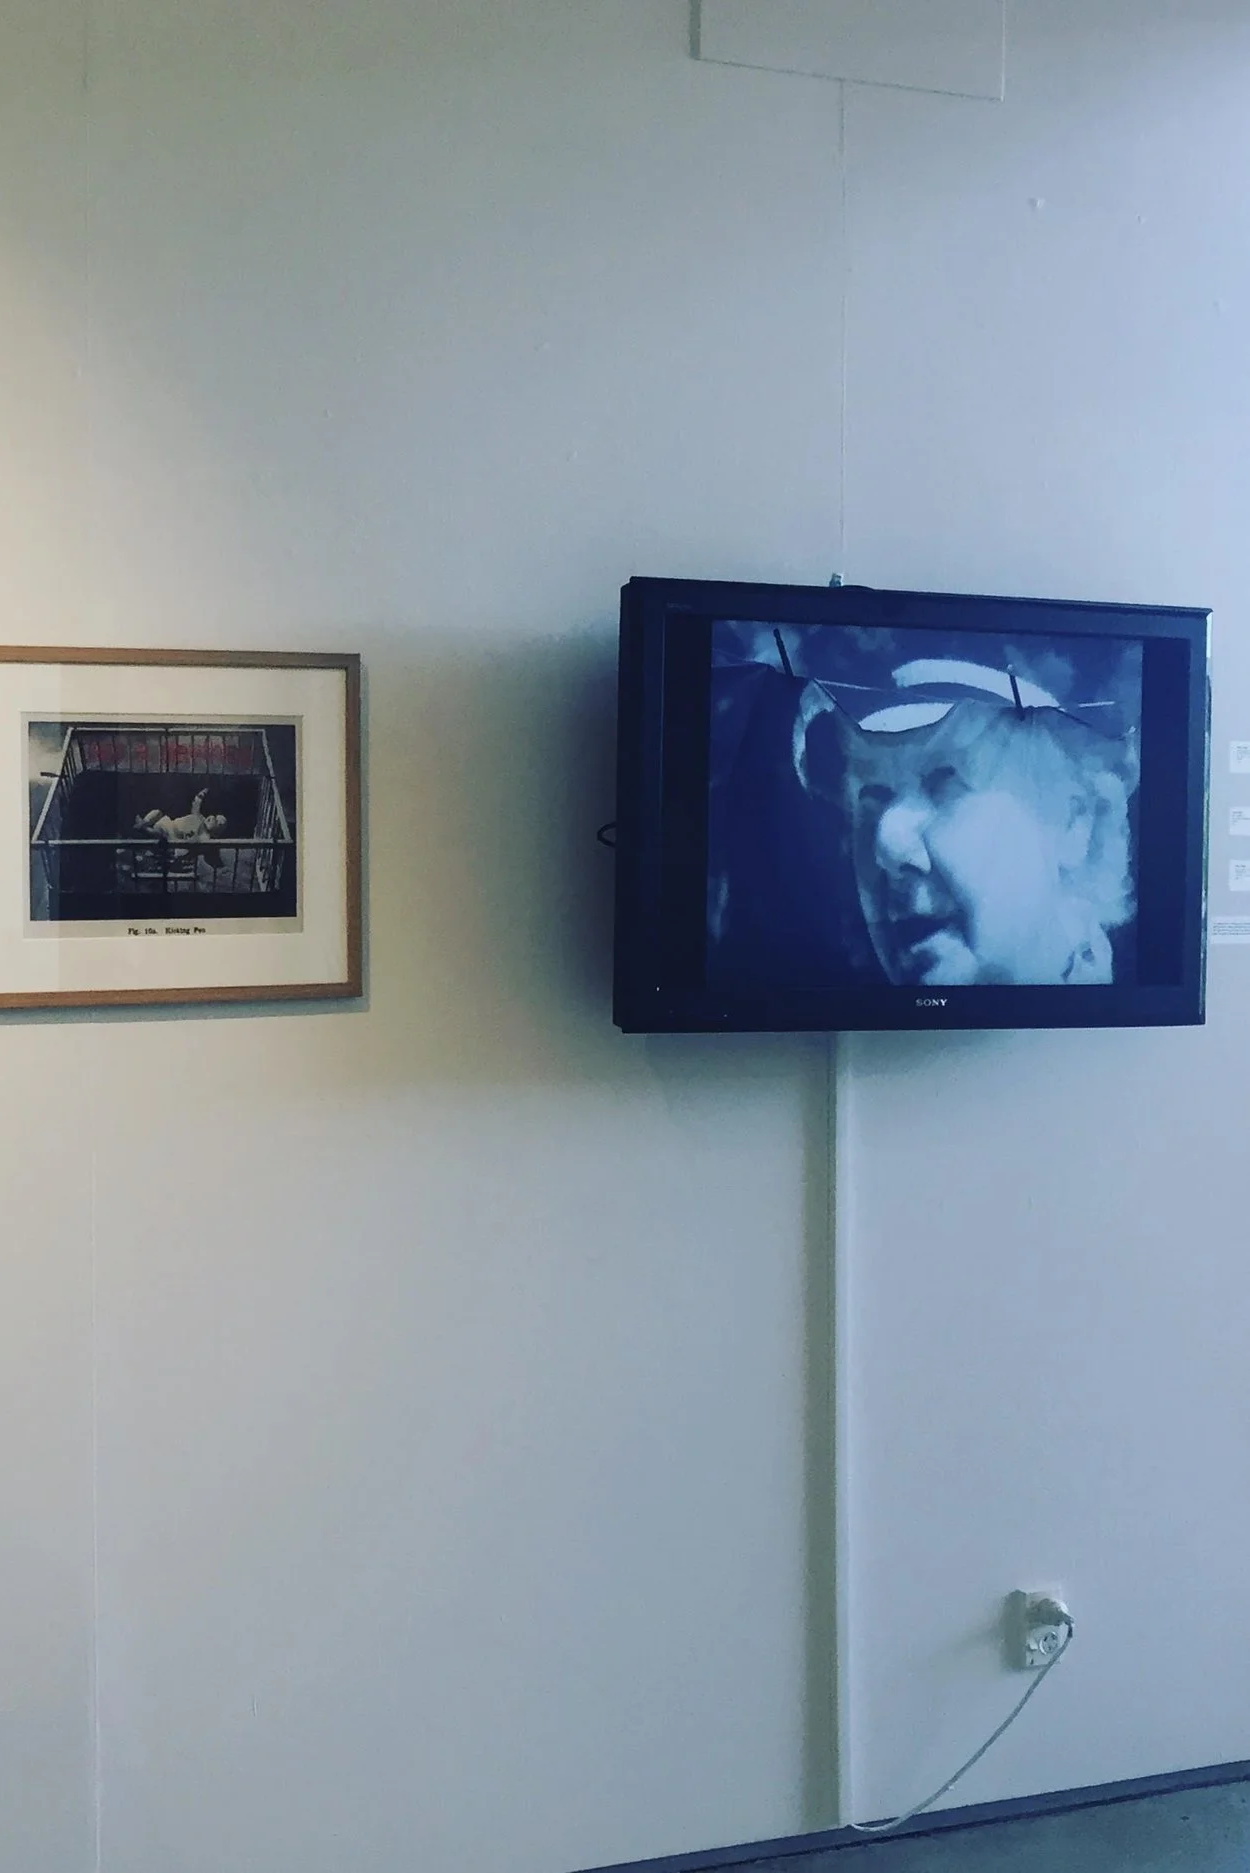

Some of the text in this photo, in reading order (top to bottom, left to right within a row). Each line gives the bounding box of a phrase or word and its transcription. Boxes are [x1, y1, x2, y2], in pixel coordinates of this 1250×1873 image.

[165, 927, 191, 935] Kicking
[193, 926, 206, 934] Pen
[915, 998, 948, 1007] SONY
